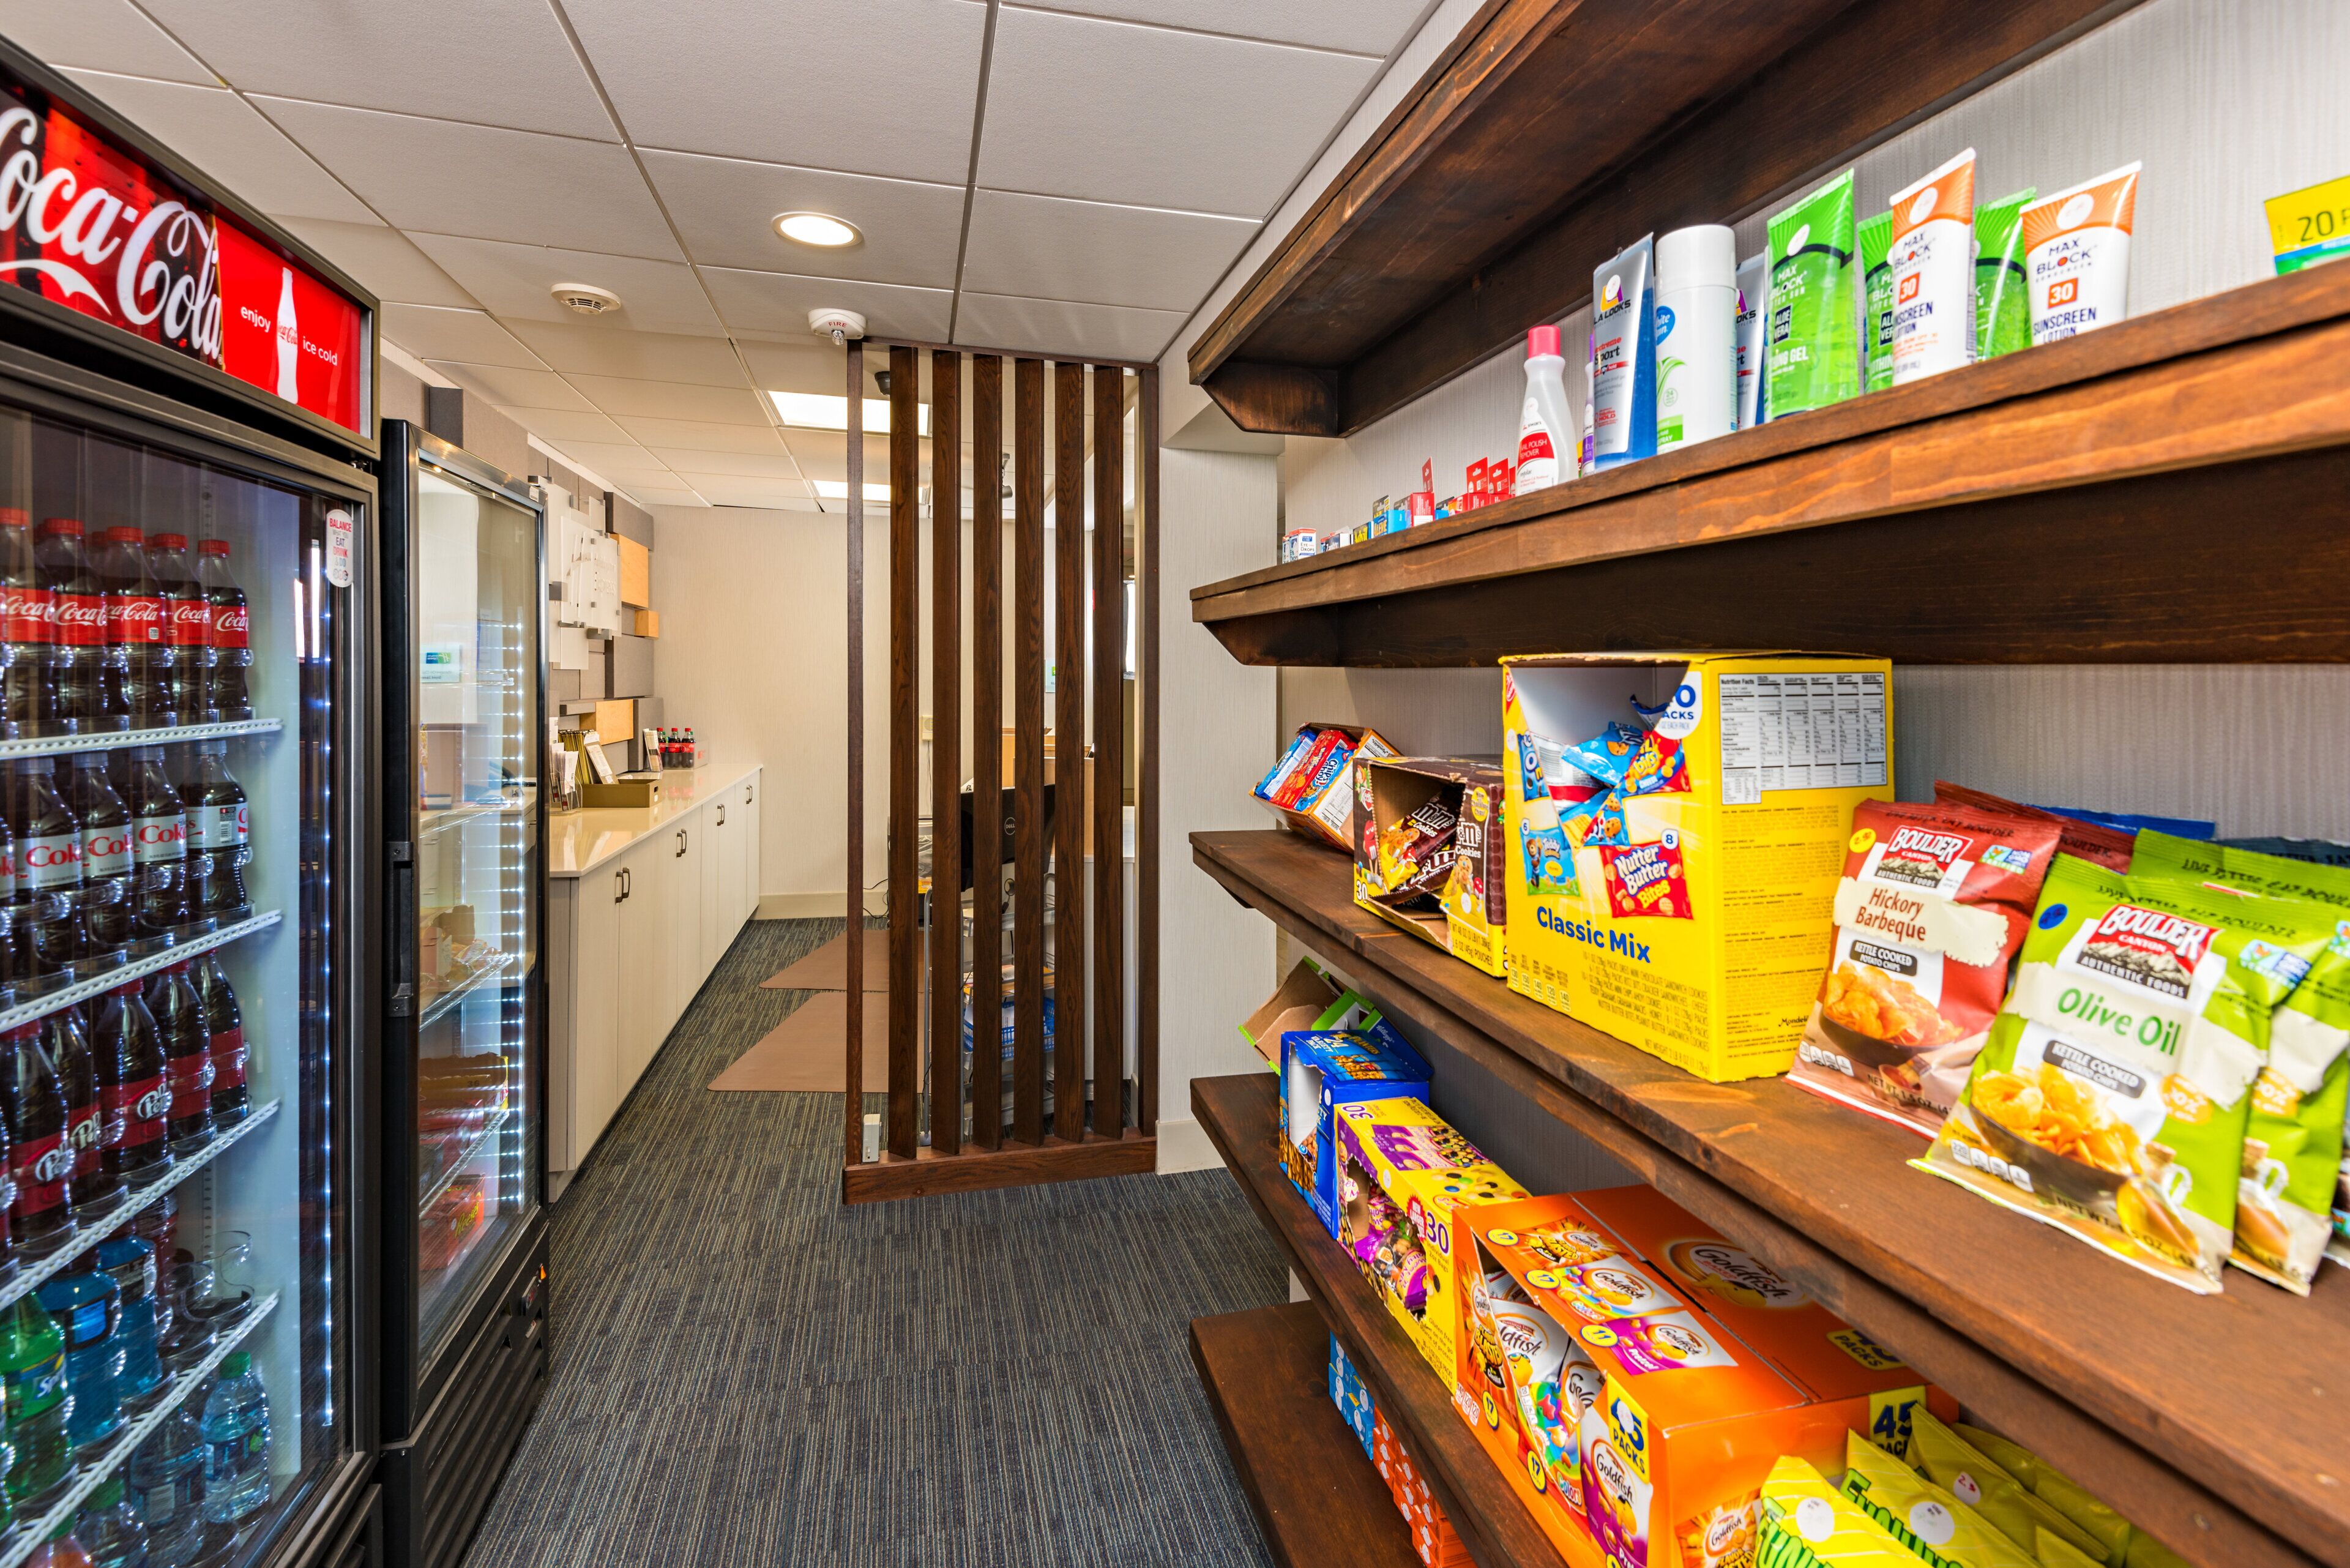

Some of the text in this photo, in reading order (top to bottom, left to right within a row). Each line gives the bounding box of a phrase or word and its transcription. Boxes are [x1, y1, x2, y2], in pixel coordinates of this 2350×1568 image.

[2297, 211, 2334, 242] 20
[1904, 231, 1925, 250] MAX
[2049, 237, 2081, 256] MAX
[1894, 244, 1931, 269] BLOCK
[2037, 248, 2092, 275] BLOCK
[1777, 264, 1798, 283] MAX
[1900, 277, 1917, 300] 30
[2050, 282, 2074, 304] 30
[241, 306, 270, 332] enjoy
[1594, 313, 1603, 325] LA
[1604, 299, 1631, 318] LOOKS
[1775, 308, 1791, 325] ALOE
[2032, 307, 2097, 336] SUNSCREEN
[1774, 324, 1789, 338] VERA
[2043, 326, 2076, 344] LOTION
[302, 336, 338, 366] ice cold
[1594, 346, 1621, 365] Sport
[1789, 346, 1808, 362] GEL
[1529, 438, 1548, 449] POLISH
[329, 518, 352, 532] BALANCE
[1354, 525, 1369, 544] Advil
[1373, 519, 1387, 537] ALEVE
[333, 547, 348, 558] DRINK
[336, 537, 345, 547] EAT
[1325, 758, 1338, 782] Chips
[1413, 822, 1438, 837] Cookies
[1523, 823, 1528, 831] 6
[1542, 837, 1561, 853] Teddy
[1665, 834, 1674, 845] 8
[1888, 828, 1963, 864] BOULDER
[1455, 845, 1482, 859] Cookies
[1614, 845, 1660, 879] Nutter
[1901, 850, 1933, 861] CANYON
[1624, 859, 1669, 896] Butter
[1876, 870, 1911, 883] AUTHENTIC
[1913, 876, 1936, 887] FOODS
[1356, 880, 1368, 903] 30
[1636, 879, 1671, 909] Bites
[1869, 887, 1925, 922] Hickory
[1537, 906, 1651, 963] Classic Mix
[1855, 907, 1927, 942] Barbeque
[2097, 905, 2209, 961] BOULDER
[2215, 913, 2298, 939] BOULDER
[1855, 943, 1913, 966] KETTLE COOKED
[2118, 933, 2167, 954] CANYON
[1474, 949, 1493, 966] POUCHES
[1860, 955, 1901, 973] POTATO CHIPS
[2081, 956, 2185, 999] AUTHENTIC FOODS
[2057, 987, 2182, 1057] Olive Oil
[1324, 1034, 1349, 1048] 24
[2051, 1042, 2139, 1088] KETTLE COOKED
[2061, 1058, 2118, 1091] POTATO CHIPS
[1868, 1073, 1884, 1086] NET
[1342, 1105, 1374, 1121] 30
[1427, 1211, 1450, 1255] 30
[1498, 1231, 1513, 1240] 17
[1570, 1233, 1599, 1249] Goldfish
[1427, 1242, 1450, 1265] Individual
[1438, 1259, 1449, 1273] Bags
[1695, 1249, 1792, 1298] Goldfish
[1537, 1273, 1555, 1283] 17
[1595, 1272, 1645, 1300] Goldfish
[1571, 1301, 1605, 1320] Colors
[1428, 1318, 1453, 1345] Gluten free
[1500, 1326, 1543, 1356] ldfish
[1658, 1327, 1702, 1356] Goldfish
[1438, 1345, 1453, 1364] protein
[1447, 1346, 1453, 1354] go
[1628, 1348, 1660, 1370] Pretzel
[1835, 1334, 1883, 1368] PACKS
[1486, 1396, 1494, 1414] 17
[1873, 1400, 1920, 1439] 45
[1613, 1428, 1646, 1475] PACKS
[1531, 1456, 1540, 1476] 17
[1597, 1453, 1633, 1501] Goldfish
[1557, 1471, 1583, 1506] Colors
[1711, 1516, 1742, 1547] Goldfish
